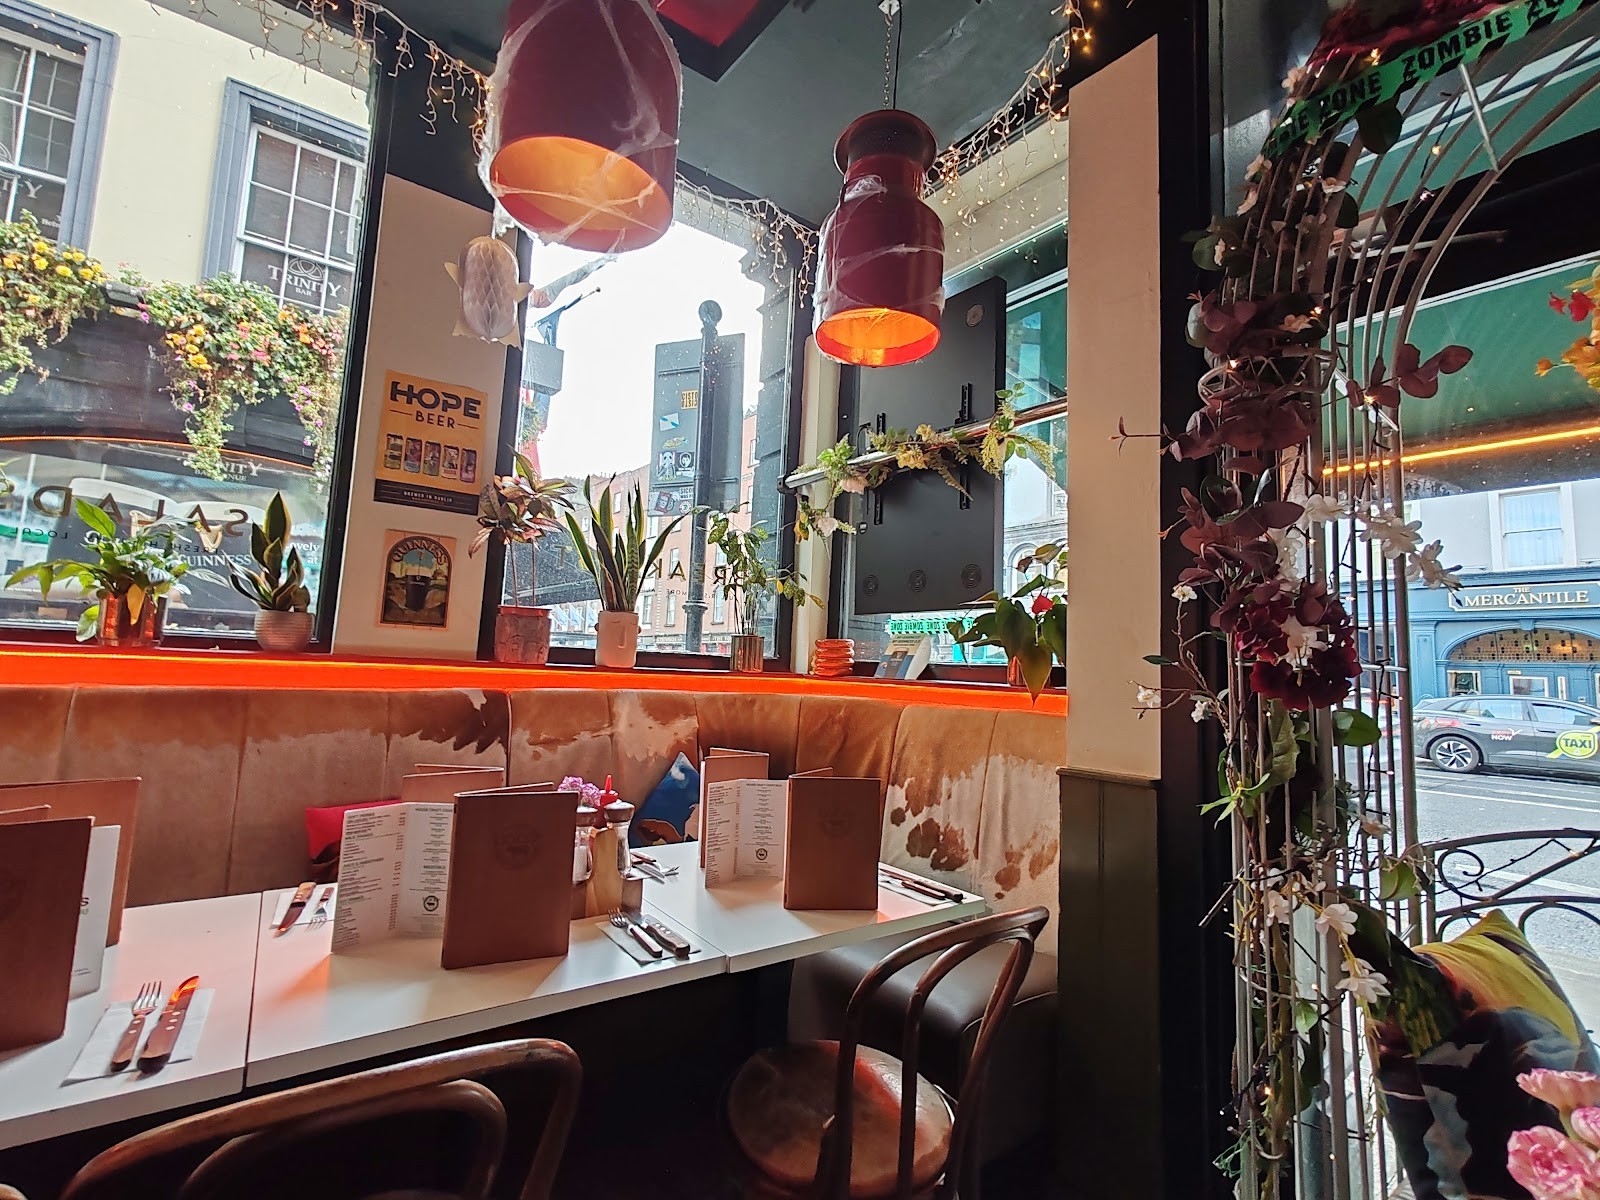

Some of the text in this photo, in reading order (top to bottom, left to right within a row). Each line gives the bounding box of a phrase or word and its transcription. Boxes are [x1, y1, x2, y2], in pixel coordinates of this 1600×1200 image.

[1402, 10, 1513, 82] ZOMBIE
[267, 264, 341, 298] TRINITY
[295, 287, 312, 297] BAR
[390, 380, 481, 420] HOPE
[415, 410, 455, 429] BEER
[286, 541, 321, 553] ovely
[392, 538, 449, 566] GUINNESS
[178, 552, 251, 568] GUINNESS
[307, 556, 319, 564] at
[1464, 590, 1590, 607] MERCANTILE
[1562, 737, 1592, 749] TAXI
